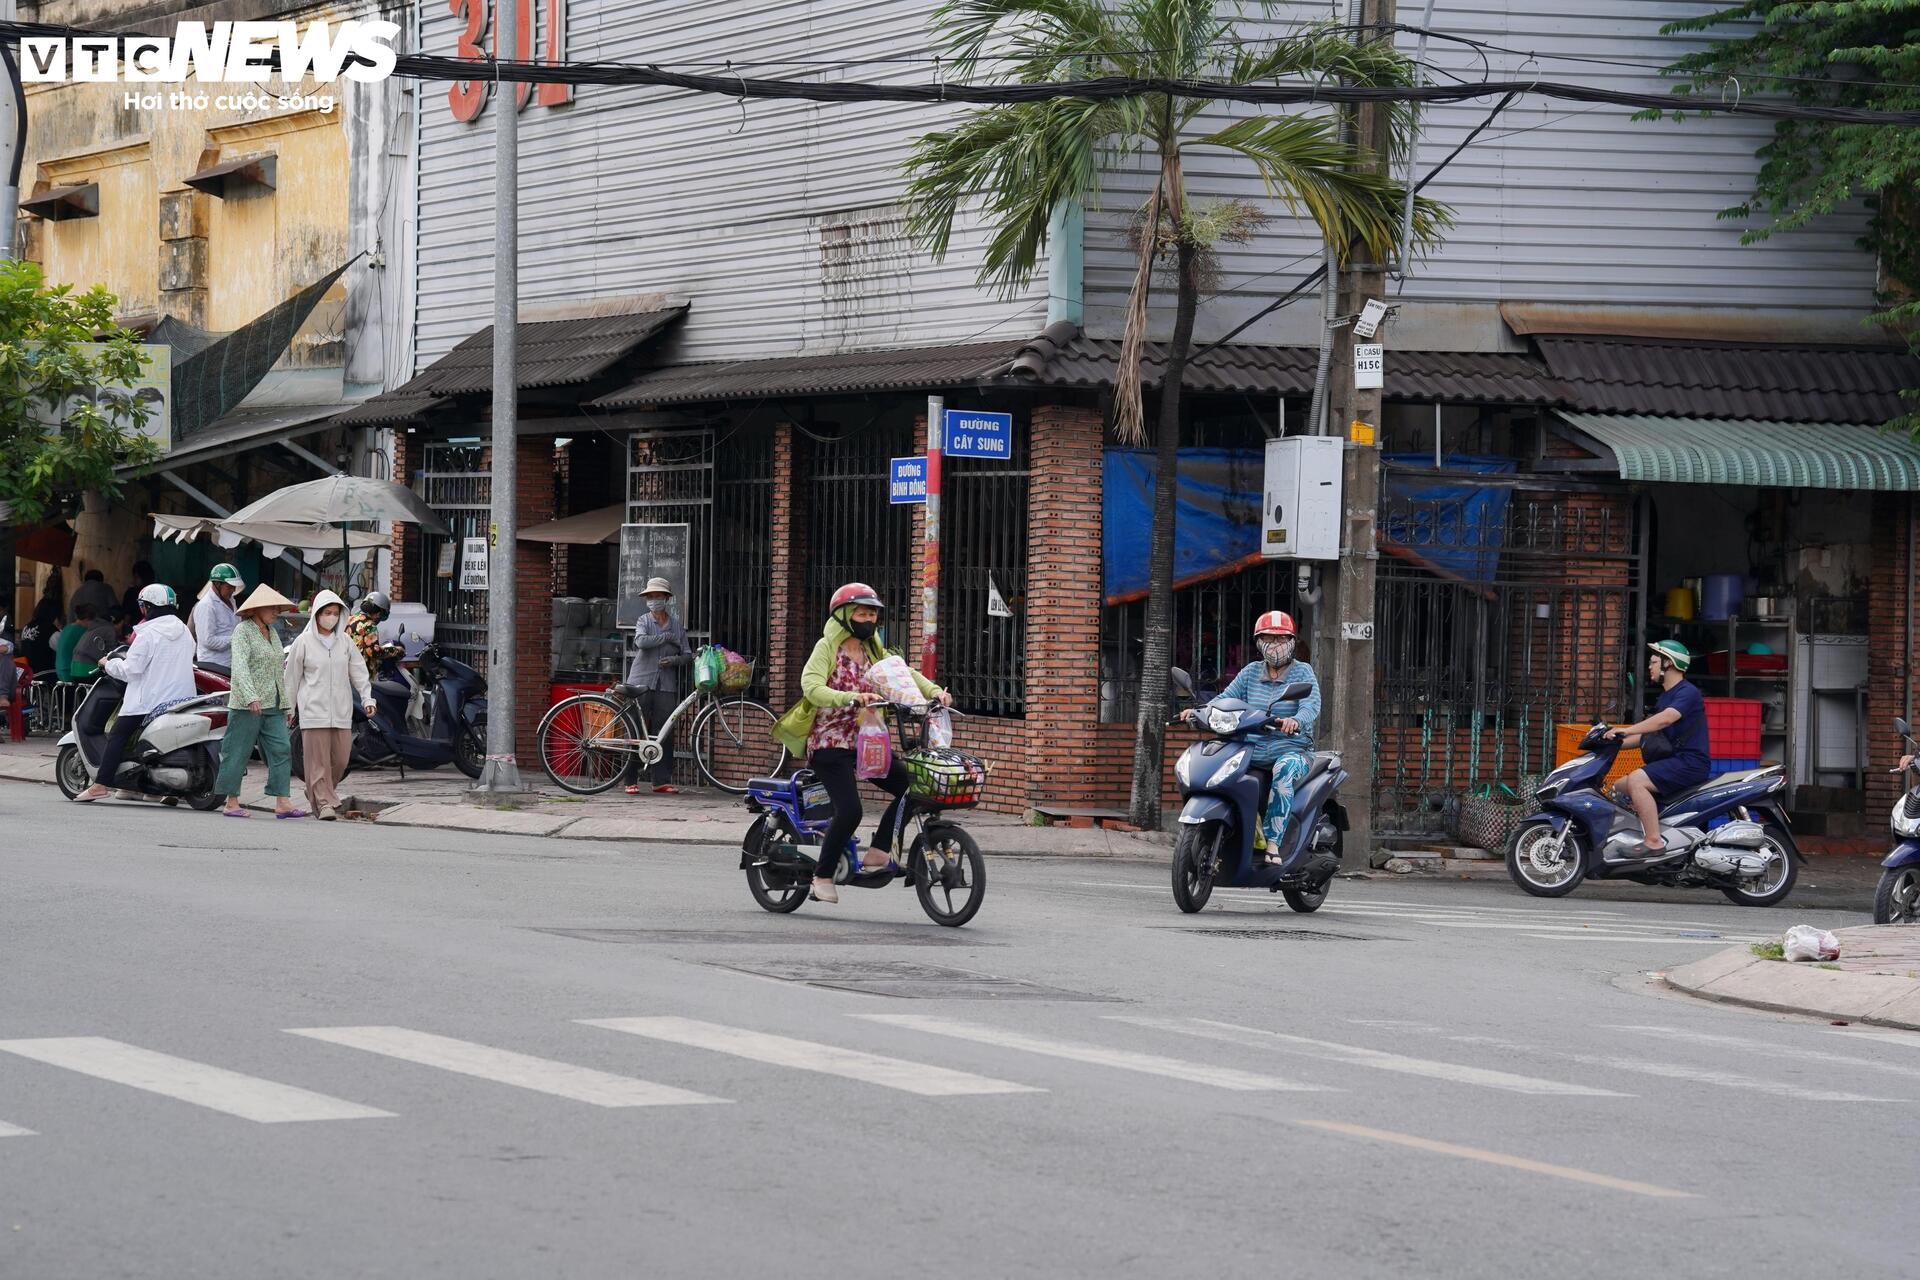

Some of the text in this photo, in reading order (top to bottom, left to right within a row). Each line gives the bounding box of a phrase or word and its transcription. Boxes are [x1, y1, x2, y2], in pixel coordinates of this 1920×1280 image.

[1364, 347, 1380, 356] CASU
[1358, 360, 1380, 370] H15C
[960, 418, 1000, 431] ĐƯỜNG
[954, 434, 1004, 452] CÂY SUNG
[898, 462, 921, 477] ĐƯỜNG
[892, 479, 926, 496] BÌNH ĐÔNG
